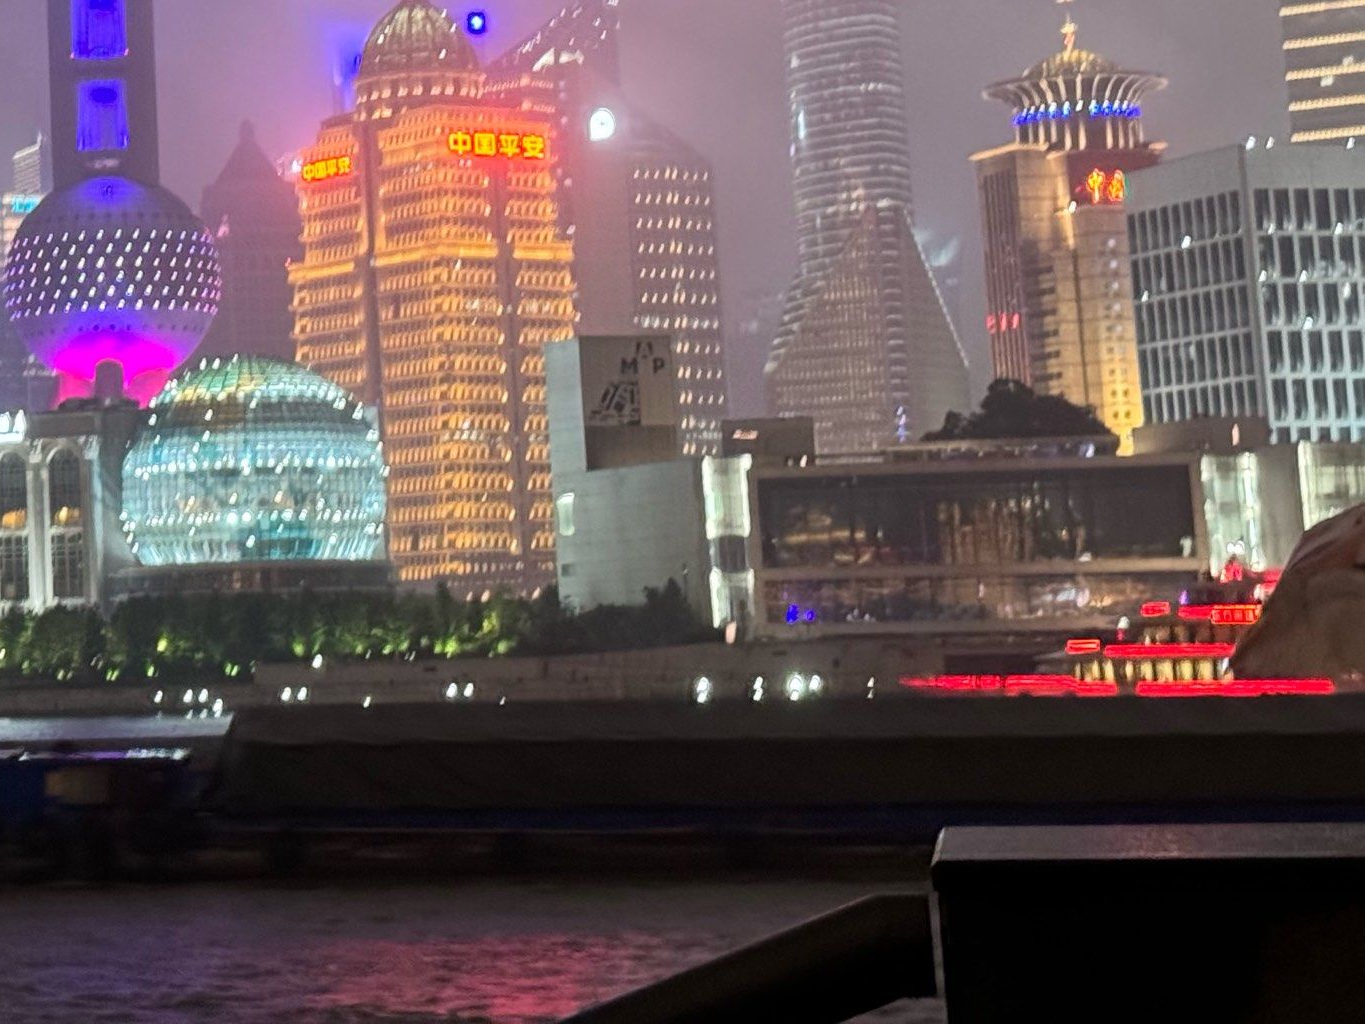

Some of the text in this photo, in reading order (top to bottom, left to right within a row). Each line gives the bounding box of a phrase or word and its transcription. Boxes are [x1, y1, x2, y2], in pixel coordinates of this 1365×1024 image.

[447, 130, 546, 159] 中国平安
[301, 156, 352, 182] 中国平安
